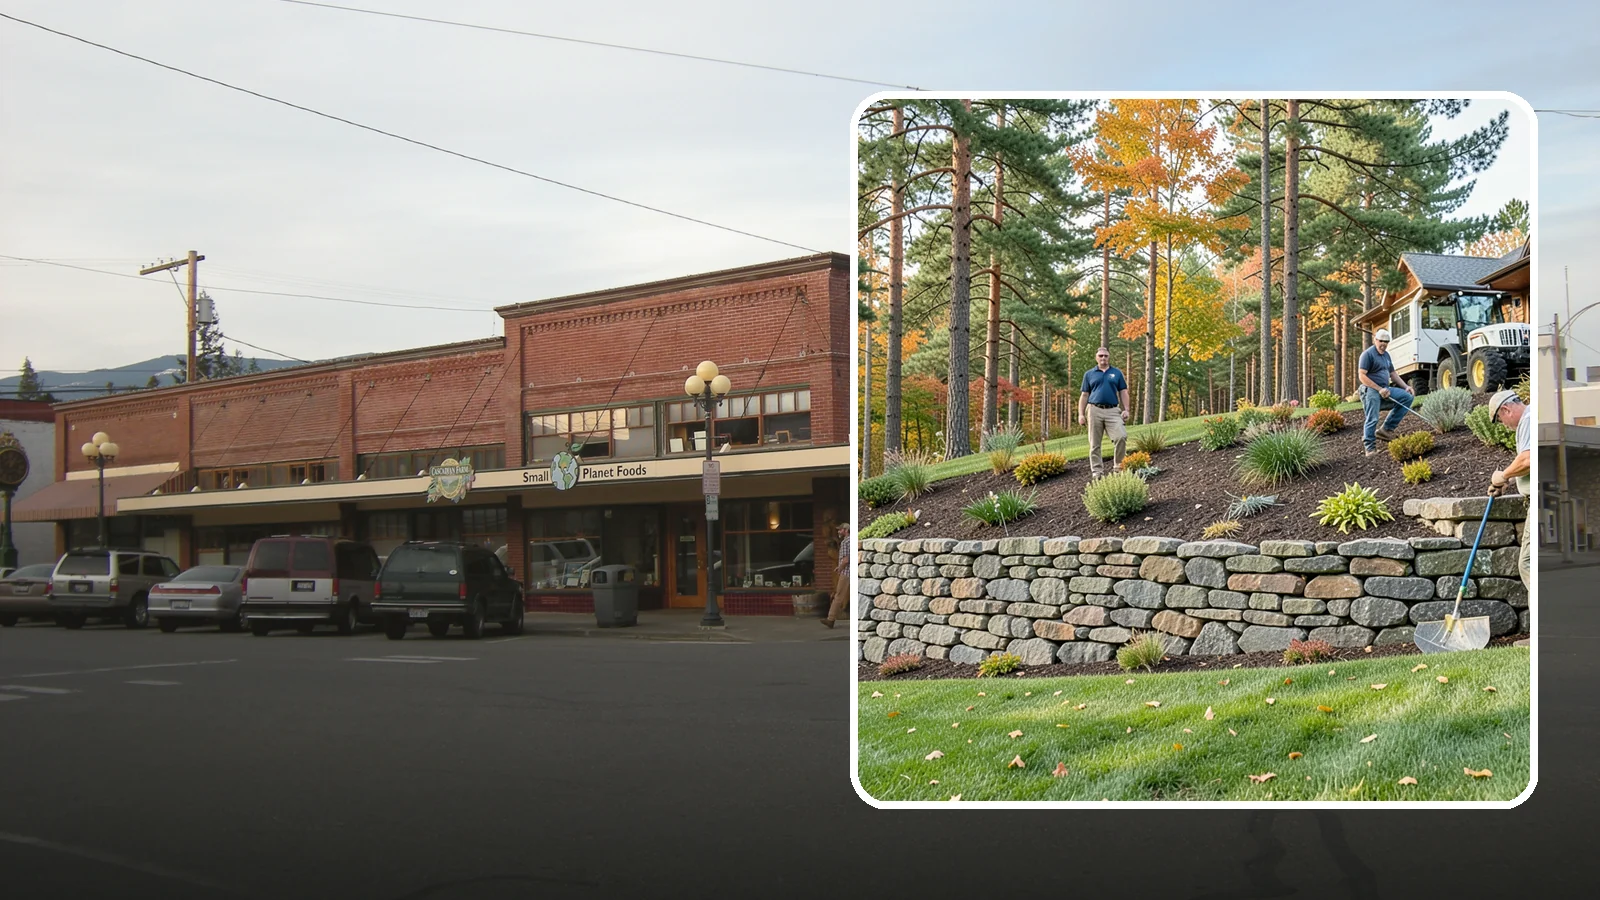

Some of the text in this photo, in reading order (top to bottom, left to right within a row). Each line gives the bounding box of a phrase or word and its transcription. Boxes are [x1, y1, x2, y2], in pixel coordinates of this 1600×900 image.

[523, 464, 647, 482] Small Planet Foods
